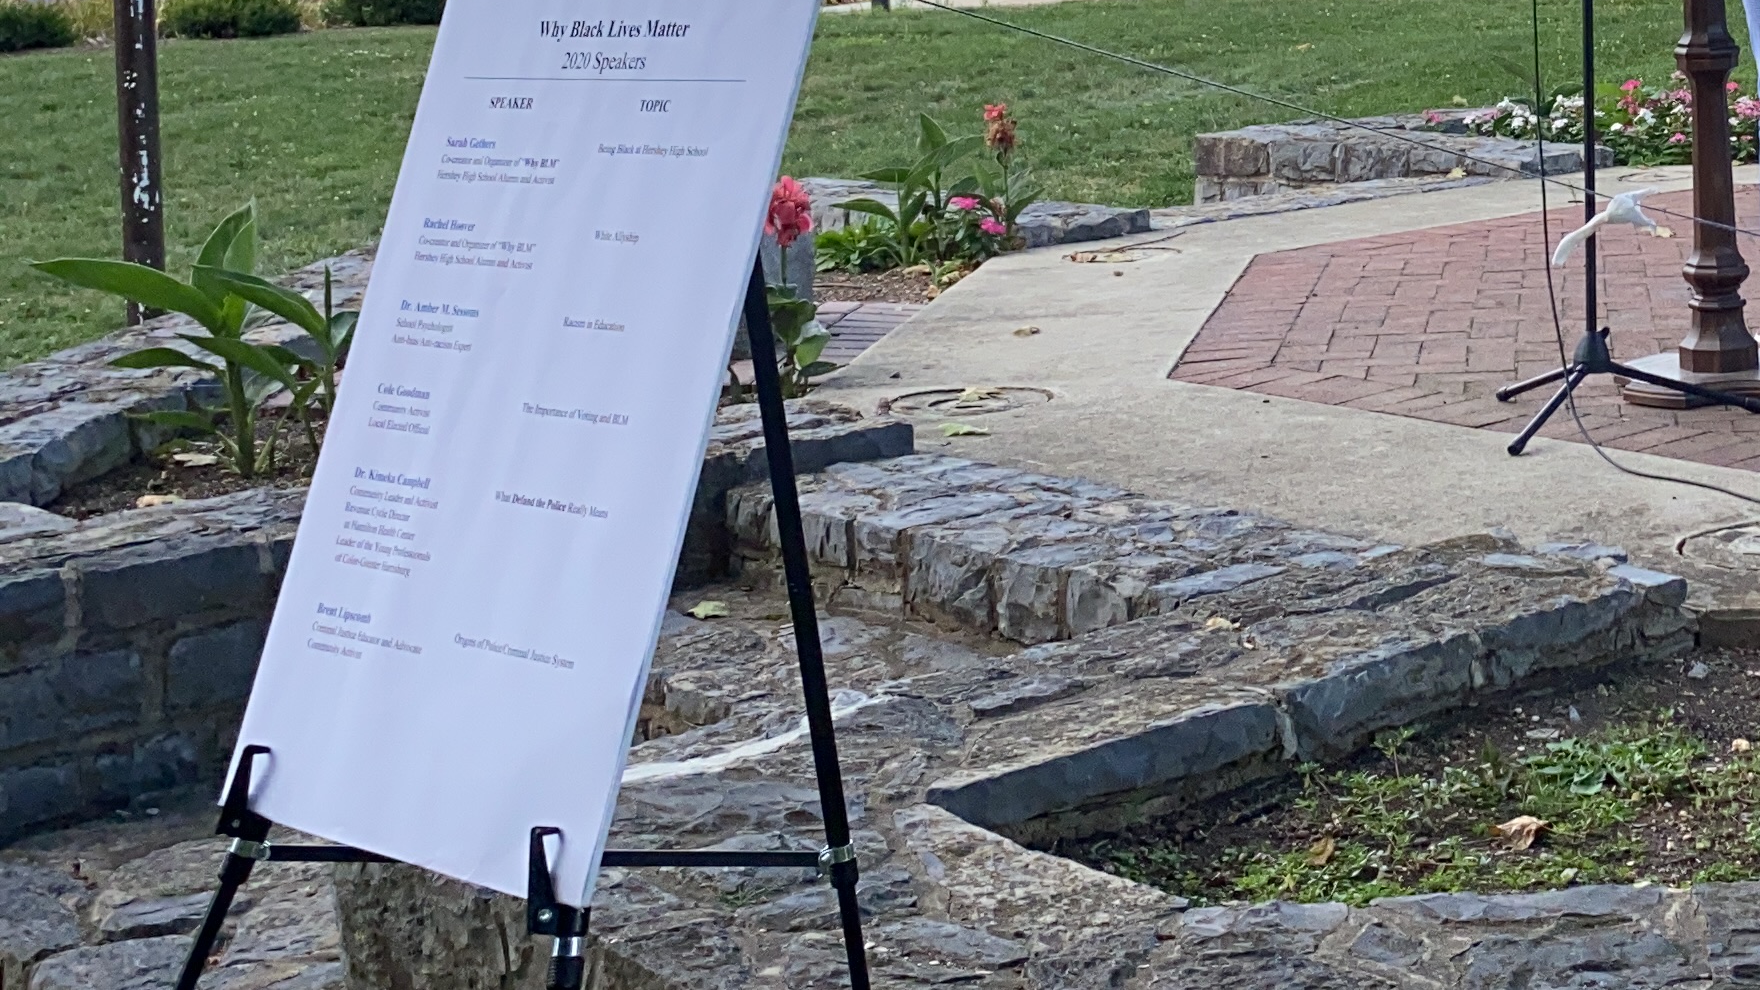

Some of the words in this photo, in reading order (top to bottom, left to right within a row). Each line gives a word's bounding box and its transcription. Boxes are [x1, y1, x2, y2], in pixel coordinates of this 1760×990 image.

[540, 20, 568, 42] Why
[570, 20, 604, 38] Black
[607, 20, 641, 38] Lives
[644, 19, 691, 38] Matter
[561, 52, 592, 70] 2020
[593, 52, 647, 74] Speakers
[489, 97, 534, 110] SPEAKER
[640, 100, 672, 113] TOPIC
[446, 136, 468, 148] Sarah
[598, 144, 616, 156] Being
[617, 144, 634, 154] Black
[642, 145, 669, 157] Hershey
[669, 146, 685, 158] High
[686, 146, 709, 157] School
[437, 170, 462, 182] Hershey
[462, 171, 477, 183] High
[478, 172, 498, 182] School
[520, 174, 532, 184] and
[424, 218, 449, 230] Rachel
[450, 220, 476, 232] Hoover
[595, 231, 612, 241] White
[415, 251, 438, 262] Hershey
[440, 253, 454, 265] High
[456, 255, 476, 265] School
[497, 258, 509, 268] and
[401, 300, 412, 310] Dr.
[414, 302, 440, 313] Amber
[396, 317, 417, 328] School
[594, 319, 625, 332] Education
[454, 341, 472, 353] Expert
[378, 383, 395, 395] Cole
[397, 385, 430, 400] Goodman
[523, 402, 534, 414] The
[535, 404, 569, 418] Importance
[569, 409, 577, 419] of
[577, 409, 598, 424] Voting
[599, 414, 612, 424] and
[612, 414, 629, 426] BLM
[368, 417, 387, 429] Local
[409, 423, 431, 434] Official
[355, 467, 366, 479] Dr.
[398, 474, 431, 490] Campbell
[384, 491, 404, 504] Leader
[496, 491, 511, 503] What
[512, 494, 536, 507] Defund
[536, 498, 546, 509] the
[547, 499, 567, 512] Police
[567, 503, 587, 518] Really
[589, 506, 609, 519] Means
[378, 525, 396, 537] Health
[336, 535, 356, 548] Leader
[393, 546, 431, 562] Professionals
[317, 602, 338, 616] Brent
[312, 621, 338, 636] Criminal
[337, 627, 357, 640] Justice
[381, 638, 394, 648] and
[394, 640, 423, 655] Advocate
[530, 649, 552, 664] Justice
[552, 654, 575, 670] System
